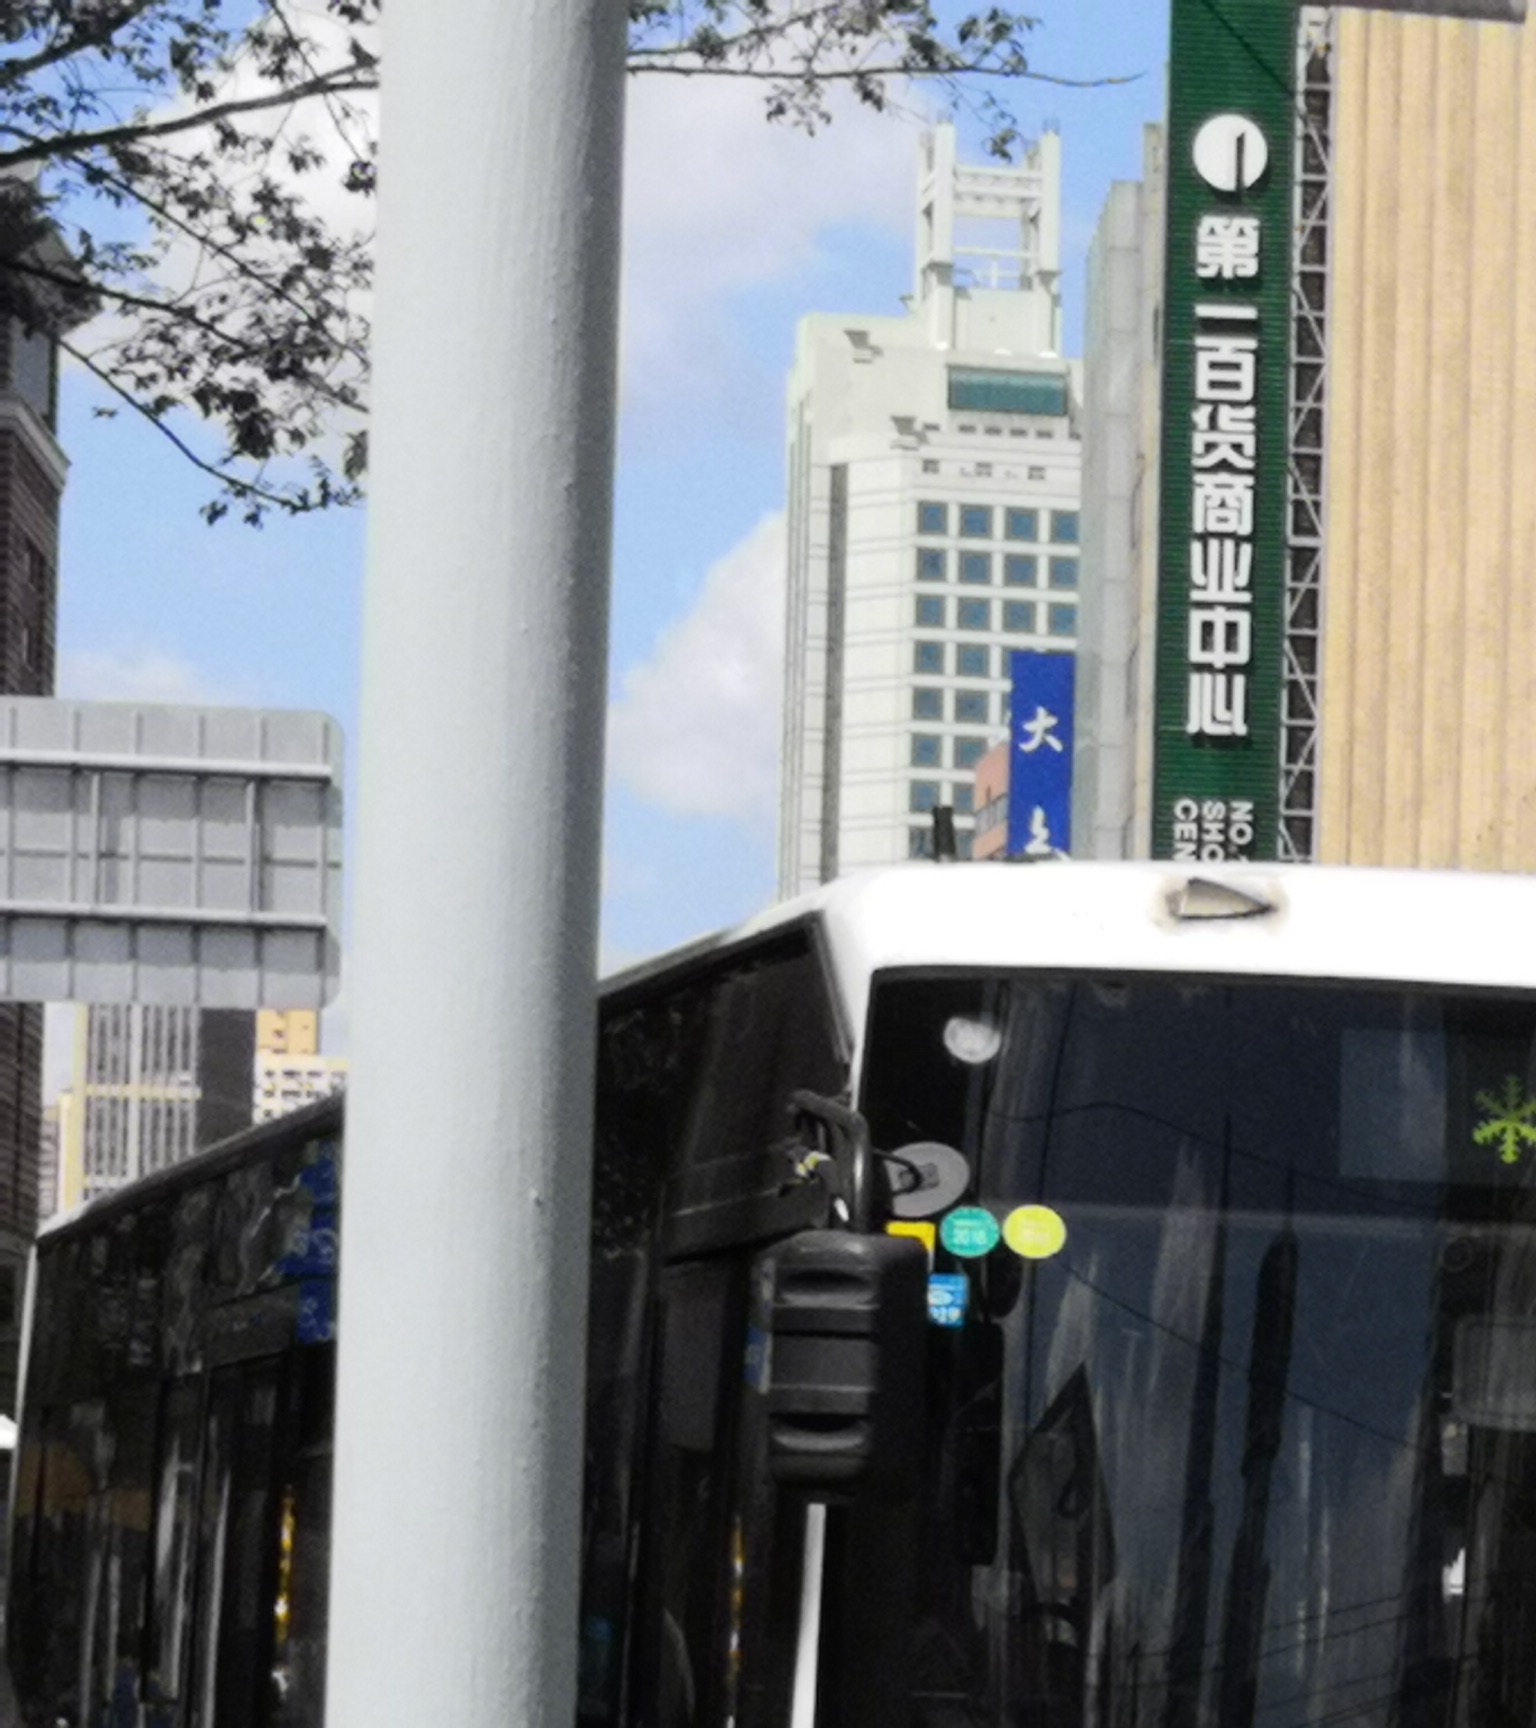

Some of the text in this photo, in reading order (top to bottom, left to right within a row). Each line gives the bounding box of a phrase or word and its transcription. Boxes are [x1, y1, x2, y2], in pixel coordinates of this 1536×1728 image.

[1186, 215, 1259, 736] 第一百货商业中心
